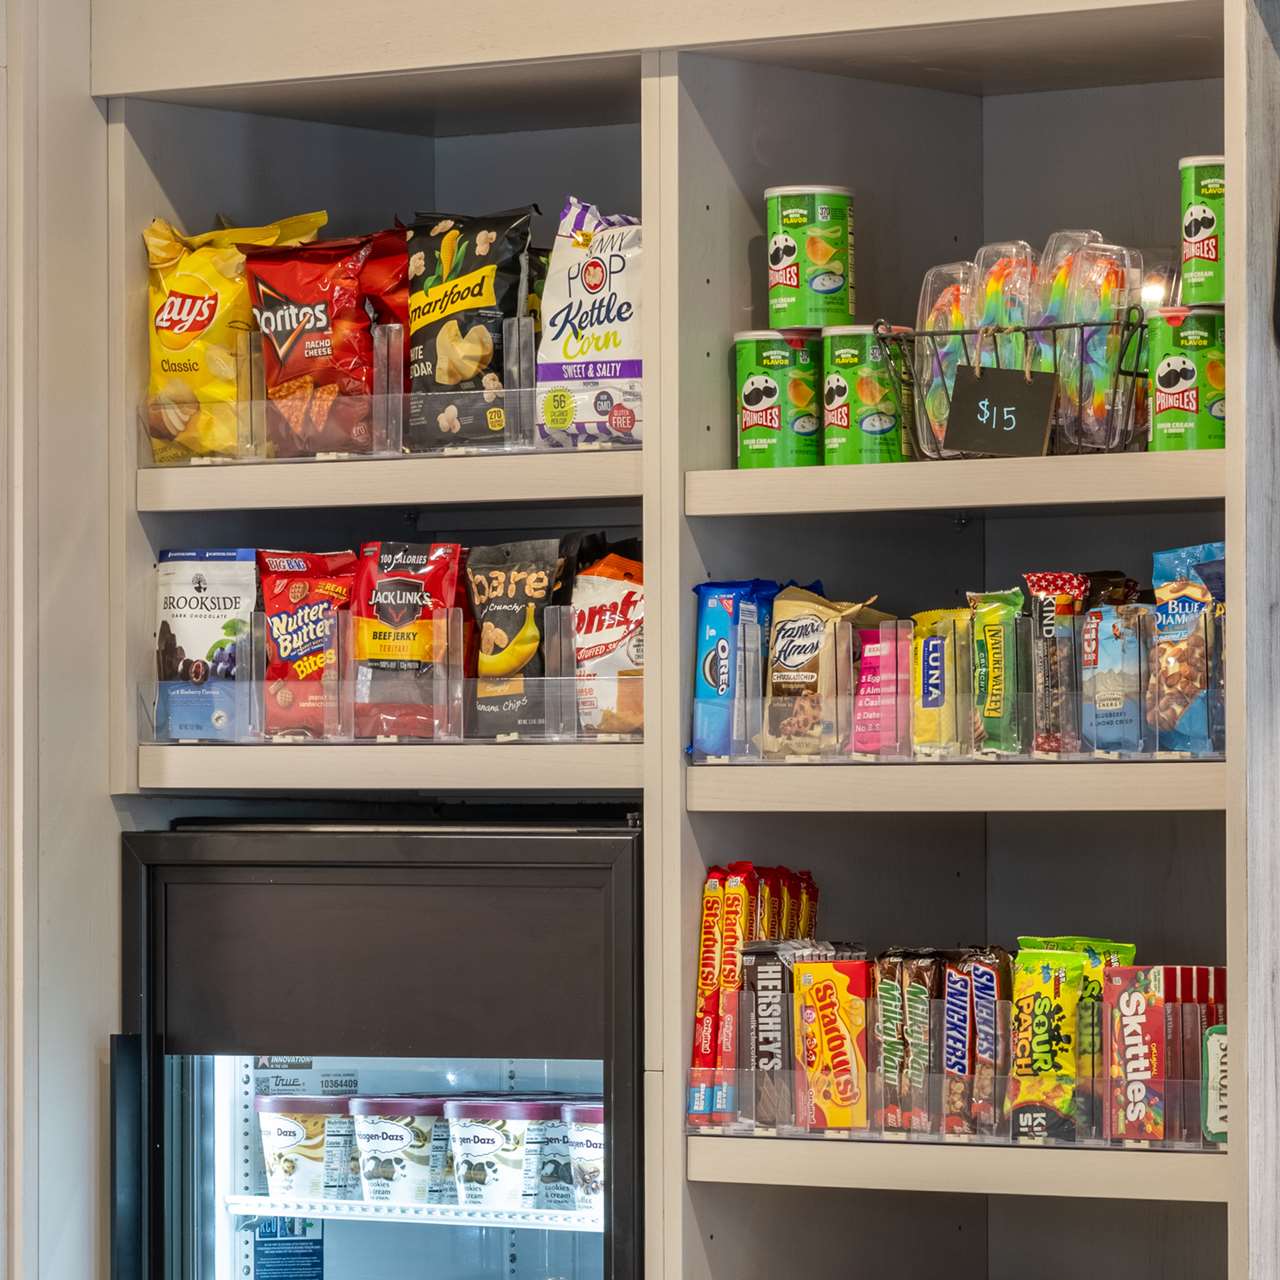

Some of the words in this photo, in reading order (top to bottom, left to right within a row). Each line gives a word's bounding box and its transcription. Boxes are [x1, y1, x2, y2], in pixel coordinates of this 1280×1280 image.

[156, 295, 217, 333] Lay's
[410, 276, 485, 323] martfood
[549, 292, 633, 341] Kettle
[304, 348, 332, 358] CHEESE
[305, 339, 331, 350] NACHO
[563, 329, 622, 360] Corn
[161, 359, 198, 373] Classic
[562, 365, 586, 378] SWEET
[588, 365, 594, 377] &
[596, 363, 621, 377] SALTY
[553, 395, 566, 408] 56
[597, 400, 611, 411] GMO
[742, 407, 779, 429] PRINGLES
[977, 398, 1016, 431] $15
[1156, 390, 1197, 414] PRINGLES
[612, 416, 632, 428] FREE
[268, 559, 285, 571] BIG
[163, 596, 241, 610] BROOKSIDE
[369, 591, 395, 605] JACK
[396, 591, 432, 605] LINK'S
[468, 568, 549, 604] bare
[272, 602, 329, 638] Nutter
[1042, 596, 1055, 638] KIND
[1168, 599, 1199, 614] BLUE
[278, 618, 334, 658] Butter
[372, 631, 392, 640] BEEF
[394, 631, 418, 641] JERKY
[990, 626, 1003, 673] NATURE
[294, 649, 336, 681] Bites
[717, 638, 730, 696] OREO
[929, 640, 942, 701] LUNA
[502, 697, 528, 712] Chips
[987, 674, 1003, 715] VALLEY
[722, 895, 742, 989] Starburst
[757, 965, 782, 1073] HERSHEY'S
[946, 969, 970, 1074] SNICKERS
[972, 963, 997, 1064] SNICKERS
[815, 984, 860, 1104] Starburst
[1015, 994, 1035, 1077] PATCH
[1032, 997, 1053, 1072] SOUR
[1120, 992, 1151, 1123] Skittles
